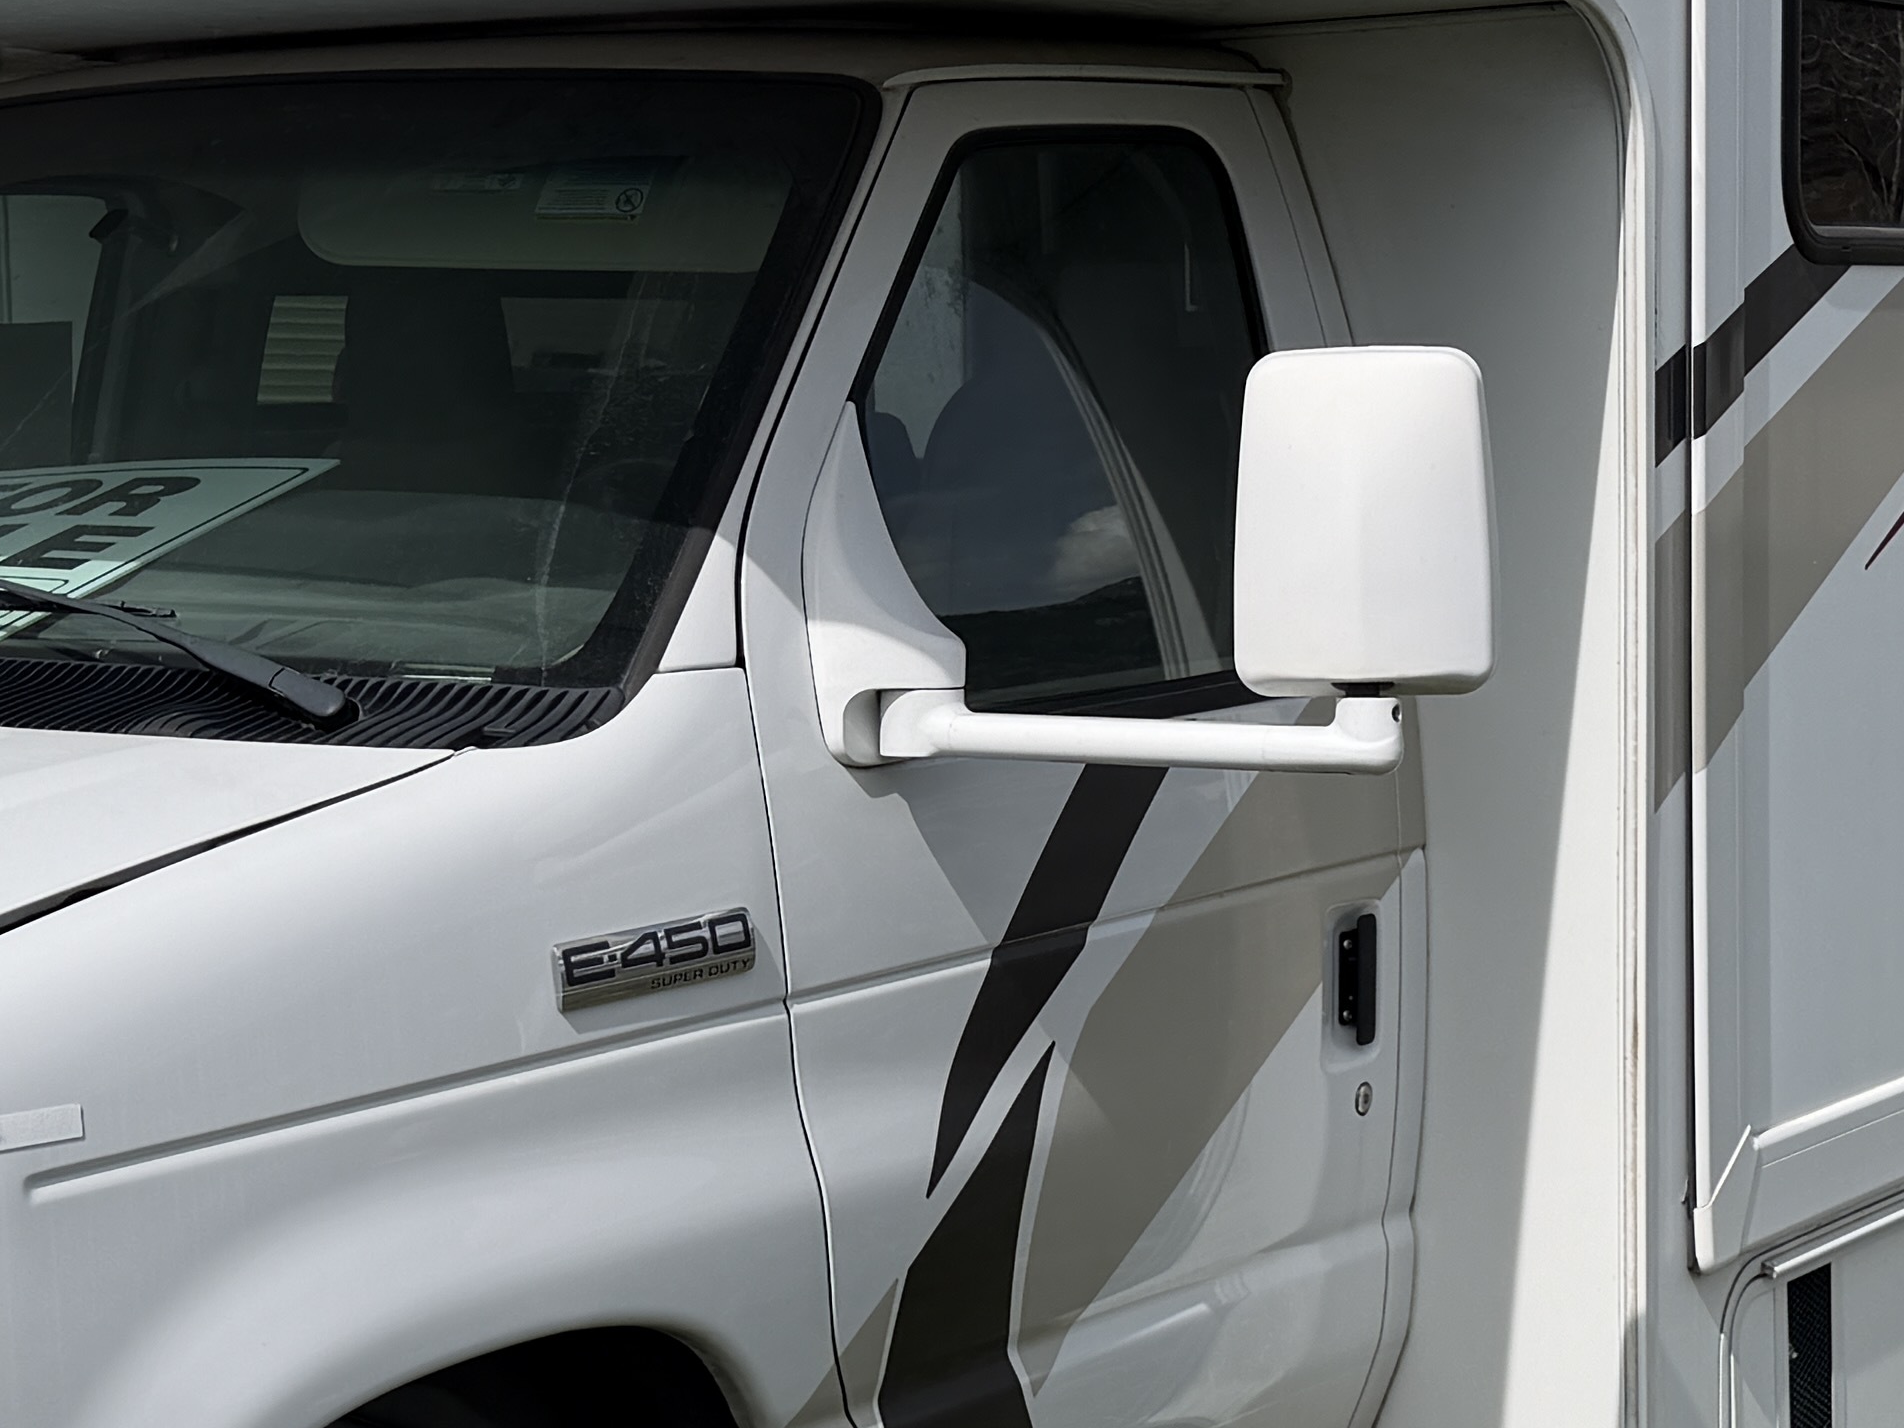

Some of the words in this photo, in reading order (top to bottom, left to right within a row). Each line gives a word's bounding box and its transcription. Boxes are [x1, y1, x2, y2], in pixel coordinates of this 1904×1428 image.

[562, 912, 753, 987] E-450
[650, 968, 704, 990] SUPER
[708, 956, 752, 977] DUTY
